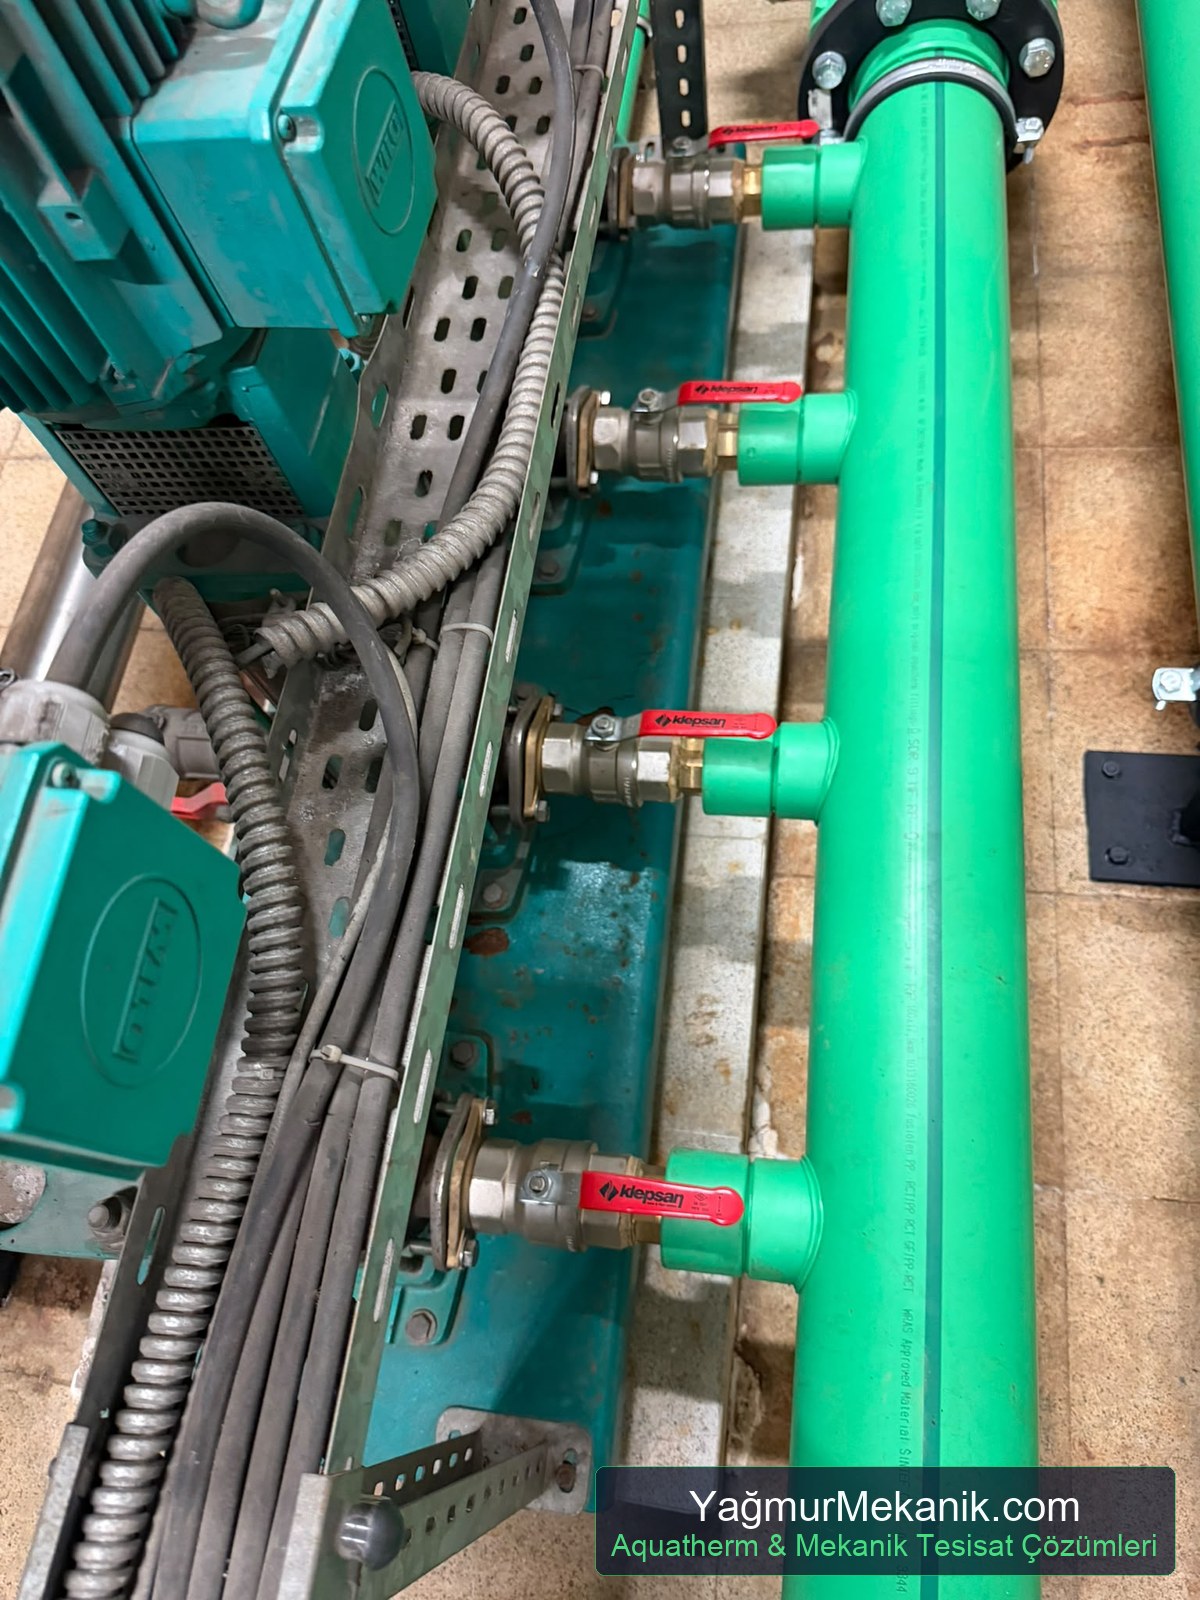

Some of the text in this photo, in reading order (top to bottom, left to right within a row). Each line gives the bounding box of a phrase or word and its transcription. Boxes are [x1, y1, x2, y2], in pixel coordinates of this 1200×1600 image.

[671, 715, 726, 728] klepsan
[620, 1185, 684, 1208] klepsan
[900, 1308, 913, 1334] WRAS
[898, 1338, 912, 1388] Approved
[897, 1391, 911, 1441] Material
